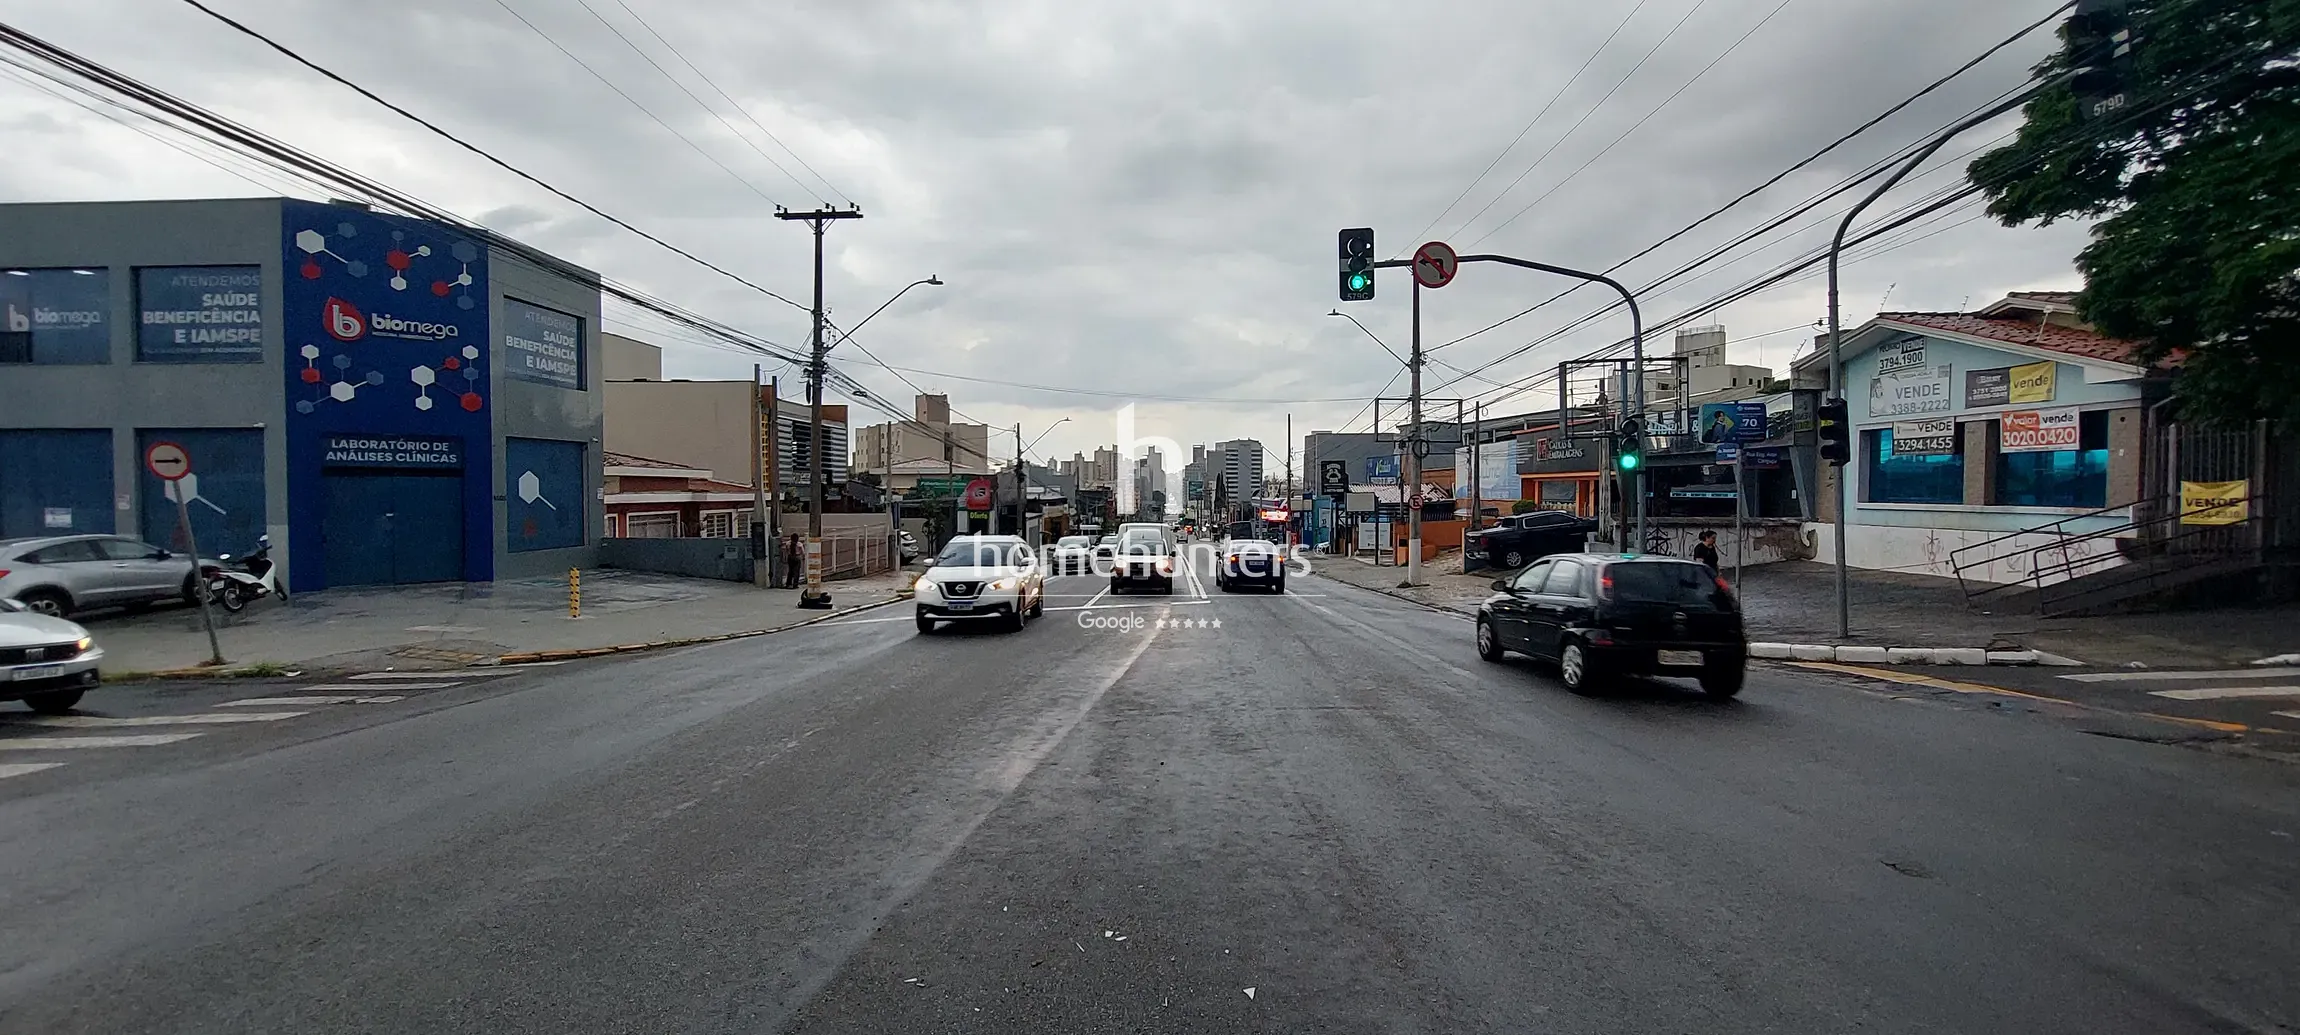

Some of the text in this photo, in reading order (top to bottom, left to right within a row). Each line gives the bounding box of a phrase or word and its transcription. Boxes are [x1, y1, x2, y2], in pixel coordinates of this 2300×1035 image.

[2093, 93, 2125, 116] 579D
[202, 290, 258, 307] SAÚDE
[34, 307, 101, 327] biomega
[142, 307, 261, 324] BENEFICÊNCIA
[371, 312, 459, 340] biomega
[174, 328, 261, 343] E IAMSPE
[543, 330, 576, 348] SAÚDE
[505, 335, 577, 362] BENEFICÊNCIA
[526, 355, 534, 368] E
[536, 357, 577, 376] IAMSPE
[1879, 351, 1923, 370] 3794.1900
[2013, 375, 2049, 389] vende
[1895, 383, 1941, 400] VENDE
[1891, 398, 1949, 415] 3388-2222
[1742, 418, 1758, 427] 70
[2042, 412, 2075, 424] vende
[1917, 421, 1953, 433] VENDE
[331, 438, 449, 451] LABORATÓRIO DE
[1899, 436, 1953, 451] 3294.1455
[2002, 428, 2076, 447] 3020.0420
[326, 450, 457, 463] ANÁLISES CLÍNICAS
[2185, 497, 2241, 508] VENDE
